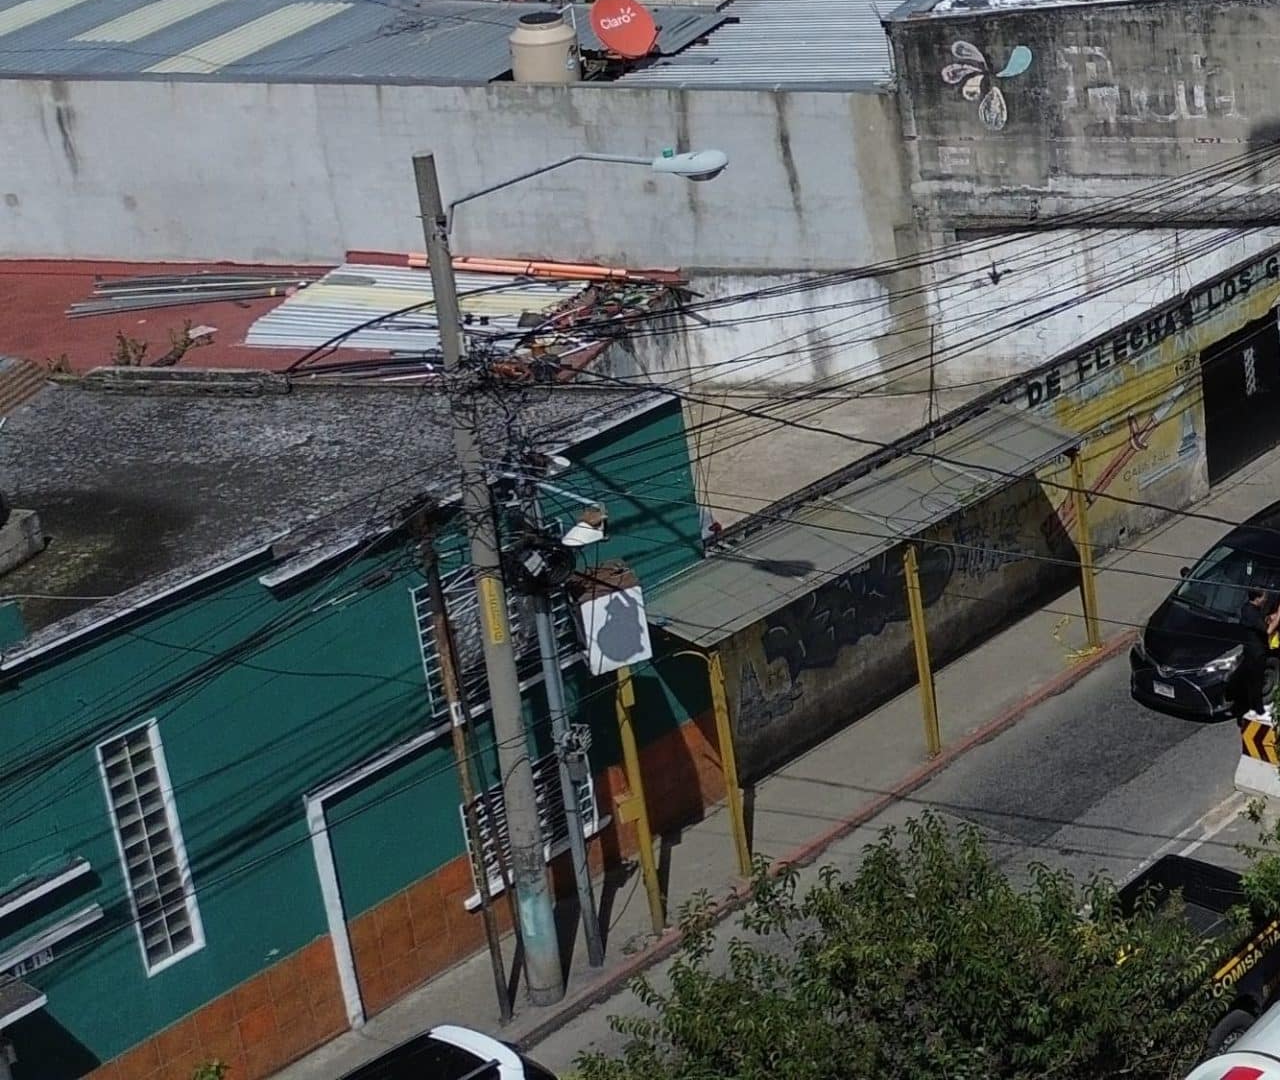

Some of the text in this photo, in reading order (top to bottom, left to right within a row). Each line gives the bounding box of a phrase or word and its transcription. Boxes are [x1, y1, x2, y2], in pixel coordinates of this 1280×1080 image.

[600, 14, 632, 31] Claro
[1027, 368, 1062, 408] DE
[1207, 270, 1251, 310] LOS
